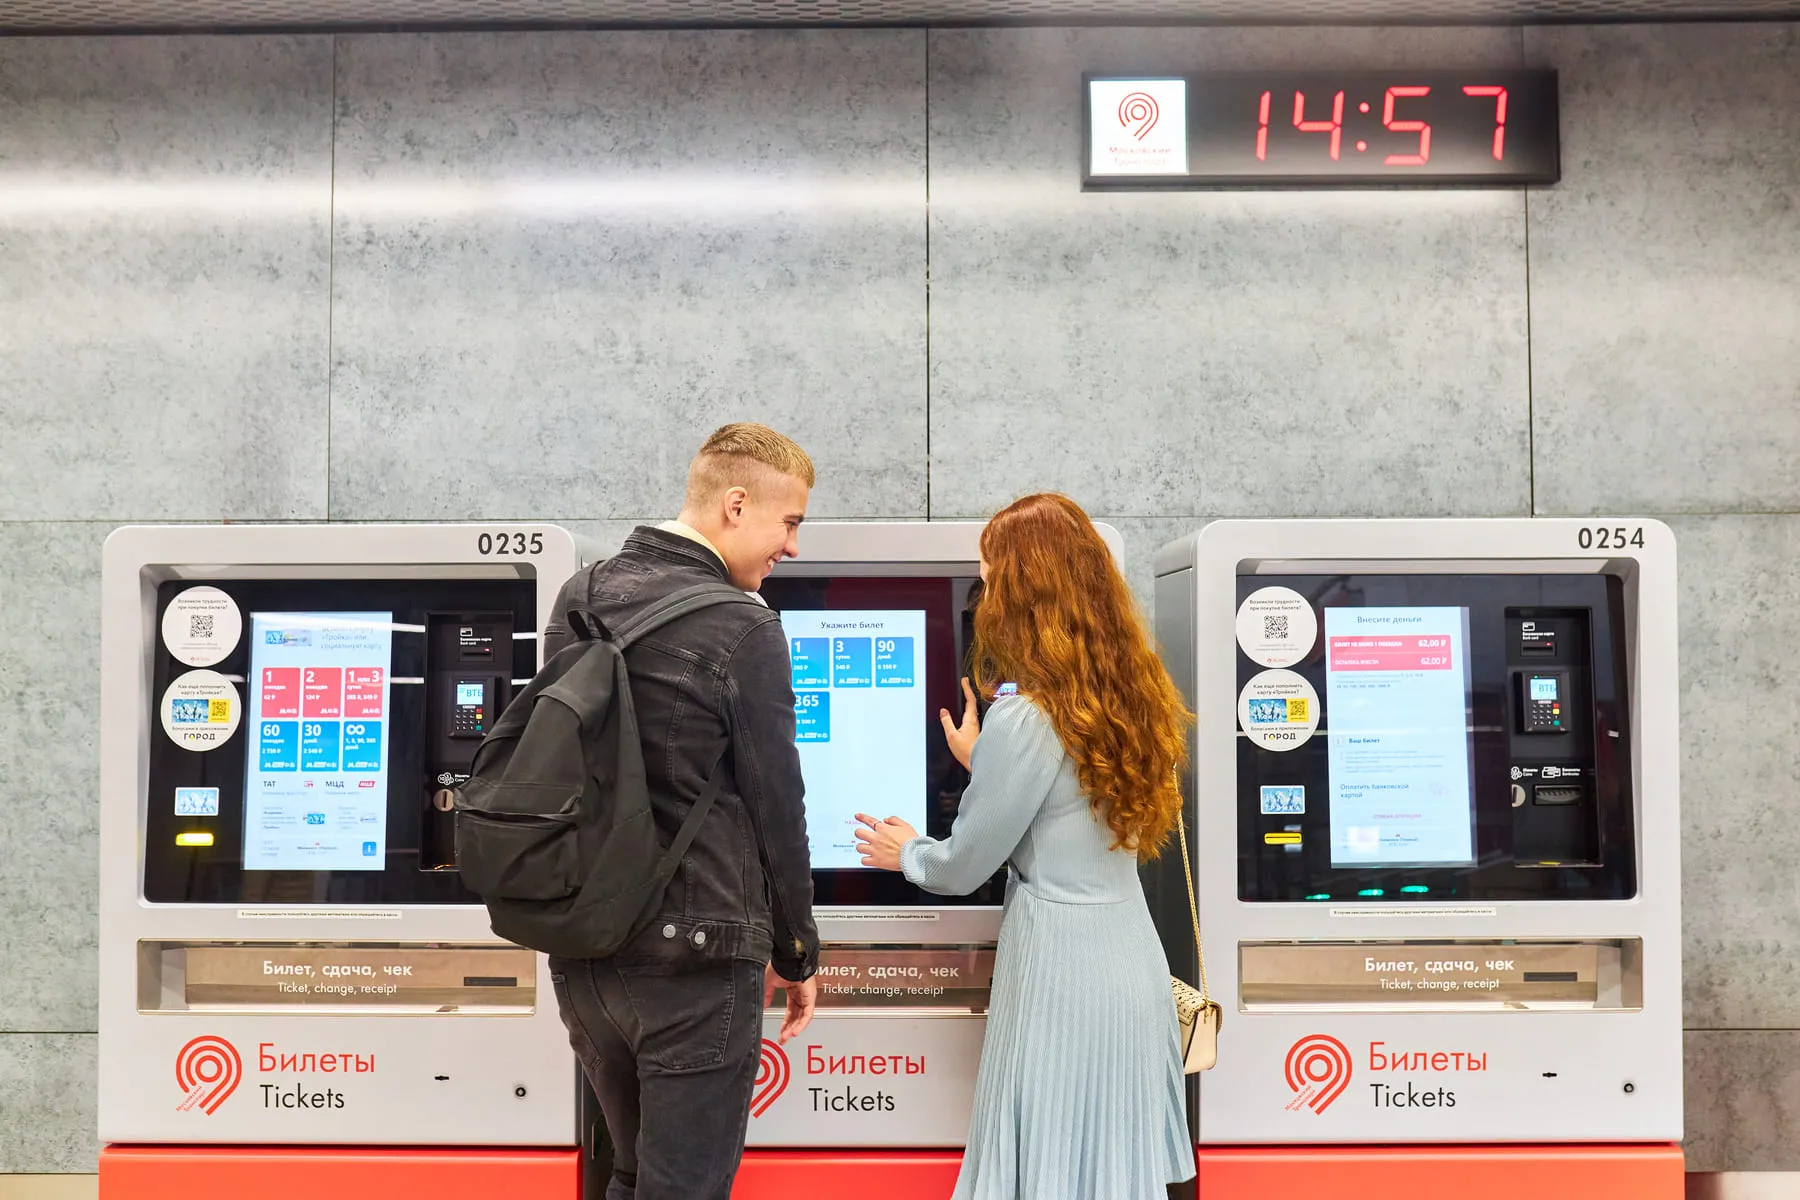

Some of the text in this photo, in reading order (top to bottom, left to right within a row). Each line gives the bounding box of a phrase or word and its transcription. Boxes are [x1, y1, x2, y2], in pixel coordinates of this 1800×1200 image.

[1256, 86, 1508, 166] 14:57
[478, 533, 543, 555] 0235
[1578, 527, 1645, 549] 0254
[820, 620, 885, 630] Укажите билет
[1392, 617, 1422, 625] деньги
[794, 641, 801, 653] 1
[835, 641, 844, 653] 3
[877, 640, 895, 653] 90
[265, 671, 273, 683] 1
[306, 671, 316, 683] 2
[348, 671, 355, 683] 1
[372, 671, 380, 683] 3
[795, 694, 820, 707] 365
[184, 733, 216, 741] ГОРОД
[263, 724, 281, 737] 60
[304, 724, 322, 737] 30
[1263, 733, 1296, 741] ГОРОД
[325, 780, 345, 789] МЦД
[263, 960, 412, 978] Билет, сдача, чек
[1365, 957, 1515, 973] Билет, сдача, чек
[815, 965, 961, 980] илет, сдача, чек
[277, 982, 397, 996] Ticket, change, receipt
[822, 983, 945, 998] Ticket, change, receipt
[1379, 977, 1500, 991] Ticket, change, receipt
[259, 1043, 375, 1072] Билеты
[807, 1045, 925, 1074] Билеты
[1369, 1041, 1486, 1071] Билеты
[260, 1083, 344, 1109] Tickets
[808, 1085, 895, 1112] Tickets
[1370, 1081, 1456, 1107] Tickets
